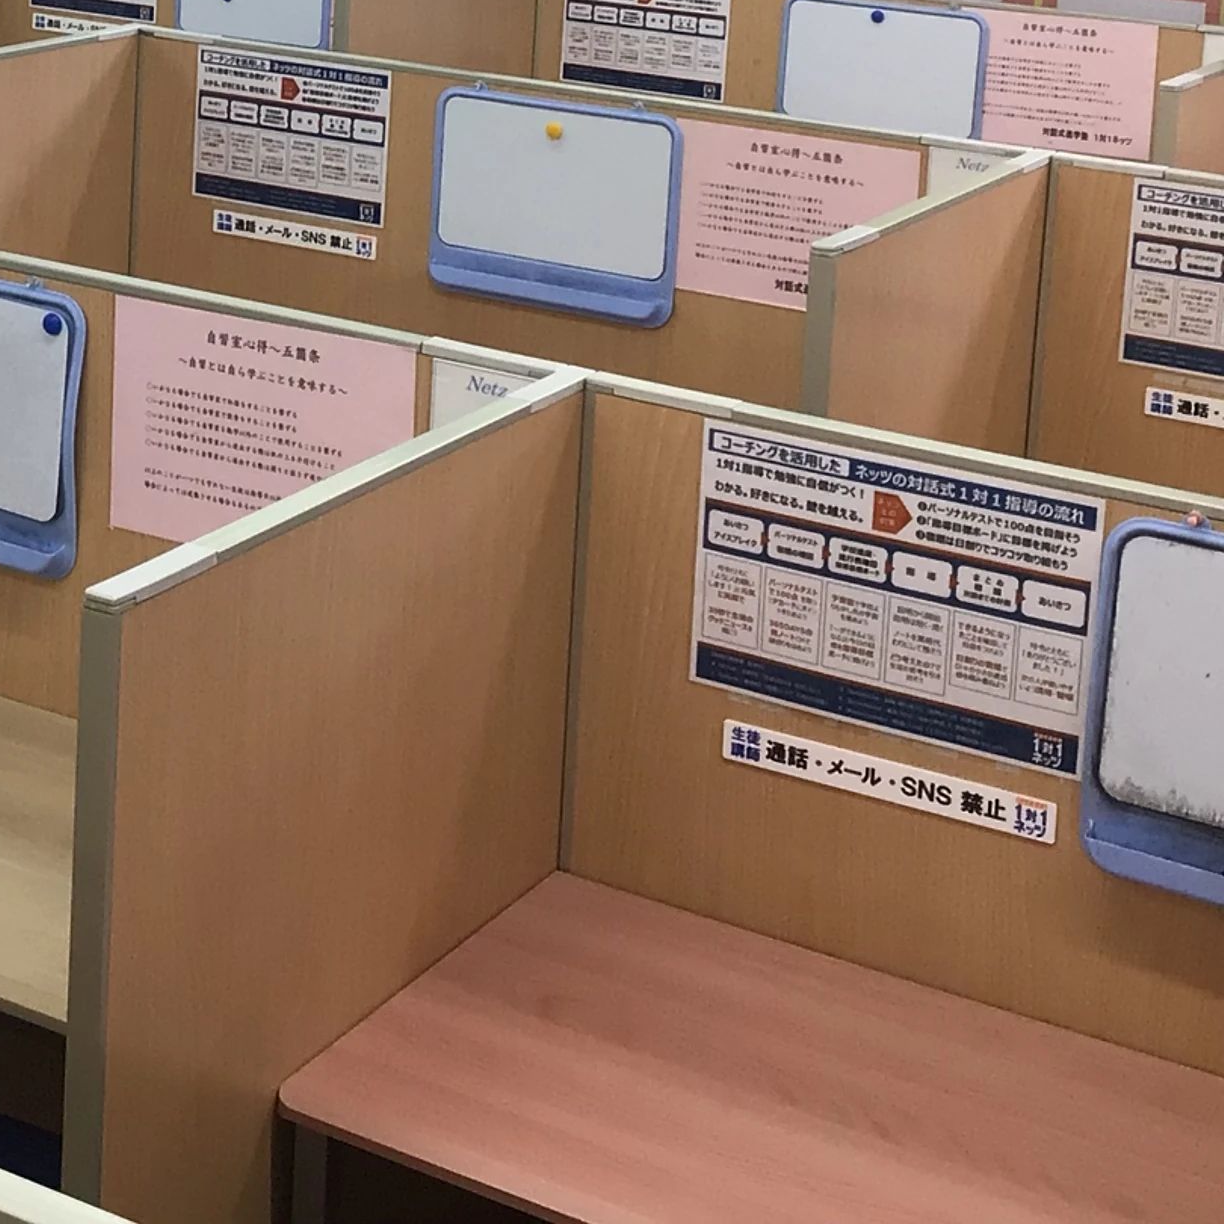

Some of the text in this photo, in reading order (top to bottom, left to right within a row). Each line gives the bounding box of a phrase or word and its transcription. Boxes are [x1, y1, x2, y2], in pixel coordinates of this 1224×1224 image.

[234, 218, 353, 251] 通話・メール・SNS 禁止
[207, 329, 321, 364] 自習室心得～五箇条
[466, 375, 508, 399] Netz
[1177, 399, 1224, 419] 通話・
[720, 435, 841, 474] コーチングを活用した
[854, 463, 1085, 526] ネッツの対話式1対1指導の流れ
[731, 726, 761, 745] 生徒
[765, 739, 1007, 822] 通話・メール・SNS 禁止
[1014, 803, 1048, 826] 1対1
